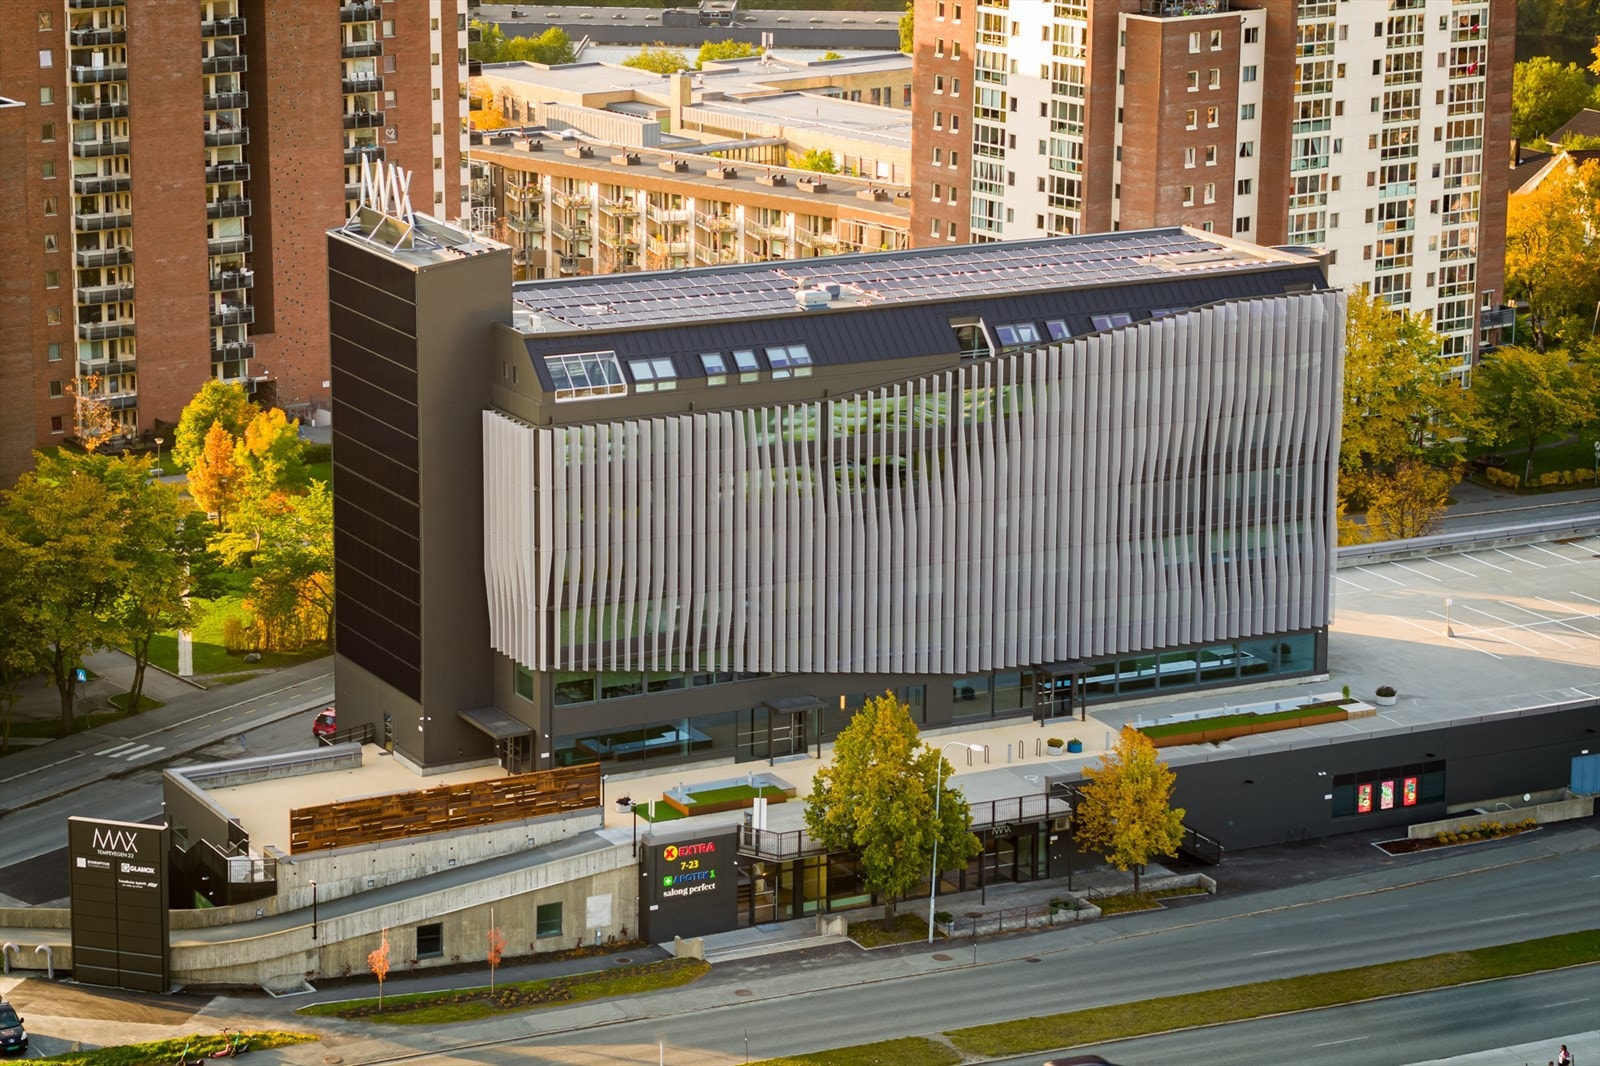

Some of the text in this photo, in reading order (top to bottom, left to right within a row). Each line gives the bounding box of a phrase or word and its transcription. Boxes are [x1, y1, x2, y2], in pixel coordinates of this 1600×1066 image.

[360, 152, 414, 228] MAX
[92, 827, 138, 853] MAX
[97, 849, 127, 858] TEMPEVEGEN
[679, 842, 715, 856] EXTRA
[129, 865, 155, 874] GLAMOX
[680, 860, 699, 870] 7-23
[673, 869, 716, 884] APOTEK 1
[663, 883, 716, 898] salong perfect
